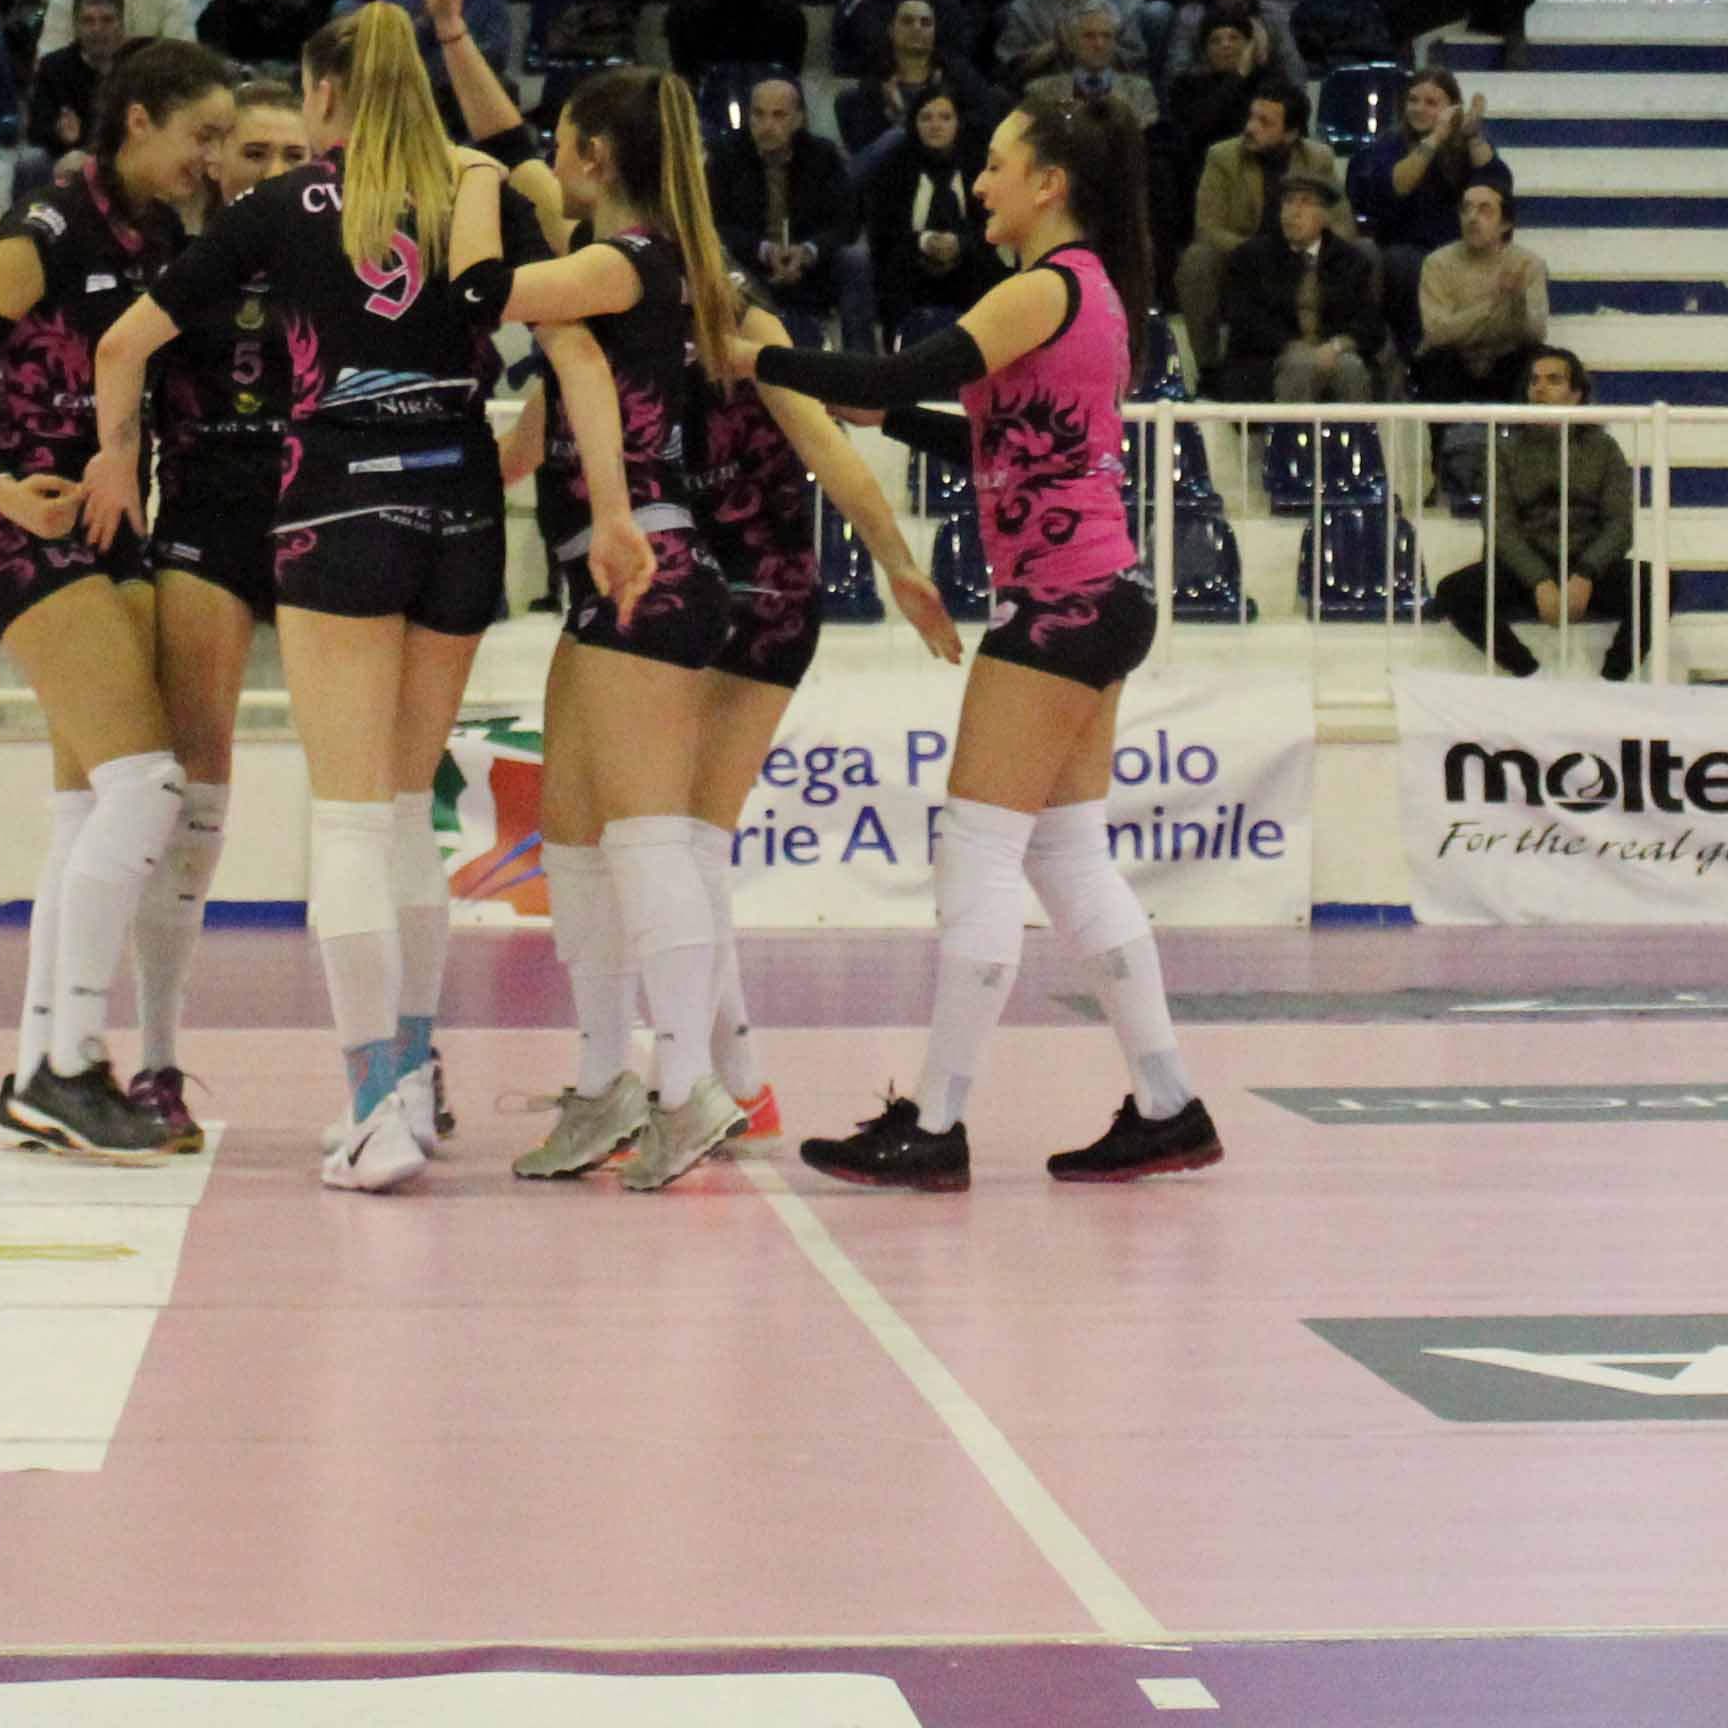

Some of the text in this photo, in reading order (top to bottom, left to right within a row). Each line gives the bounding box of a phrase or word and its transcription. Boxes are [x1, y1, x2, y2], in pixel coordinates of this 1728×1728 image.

[356, 230, 423, 321] 9
[231, 339, 263, 385] 5
[761, 745, 880, 807] ega
[731, 808, 820, 866] rie
[840, 805, 898, 864] A
[1437, 821, 1507, 859] For
[1514, 820, 1587, 858] the
[1596, 823, 1690, 863] real
